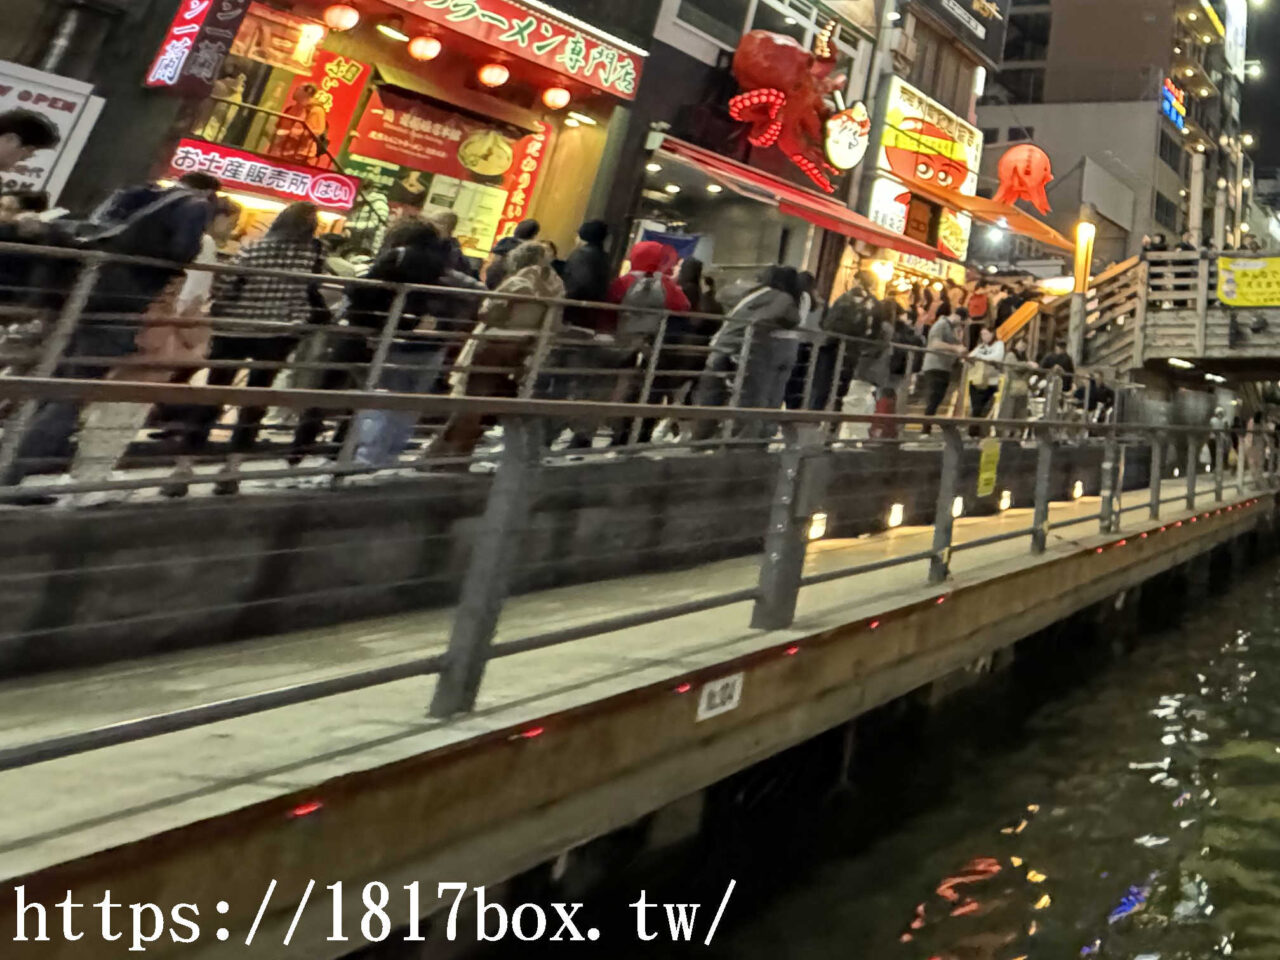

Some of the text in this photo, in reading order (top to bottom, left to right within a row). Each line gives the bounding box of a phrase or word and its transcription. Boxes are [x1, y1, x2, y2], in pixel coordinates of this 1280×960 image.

[17, 90, 78, 114] OPEN
[170, 146, 312, 197] お土産販売所
